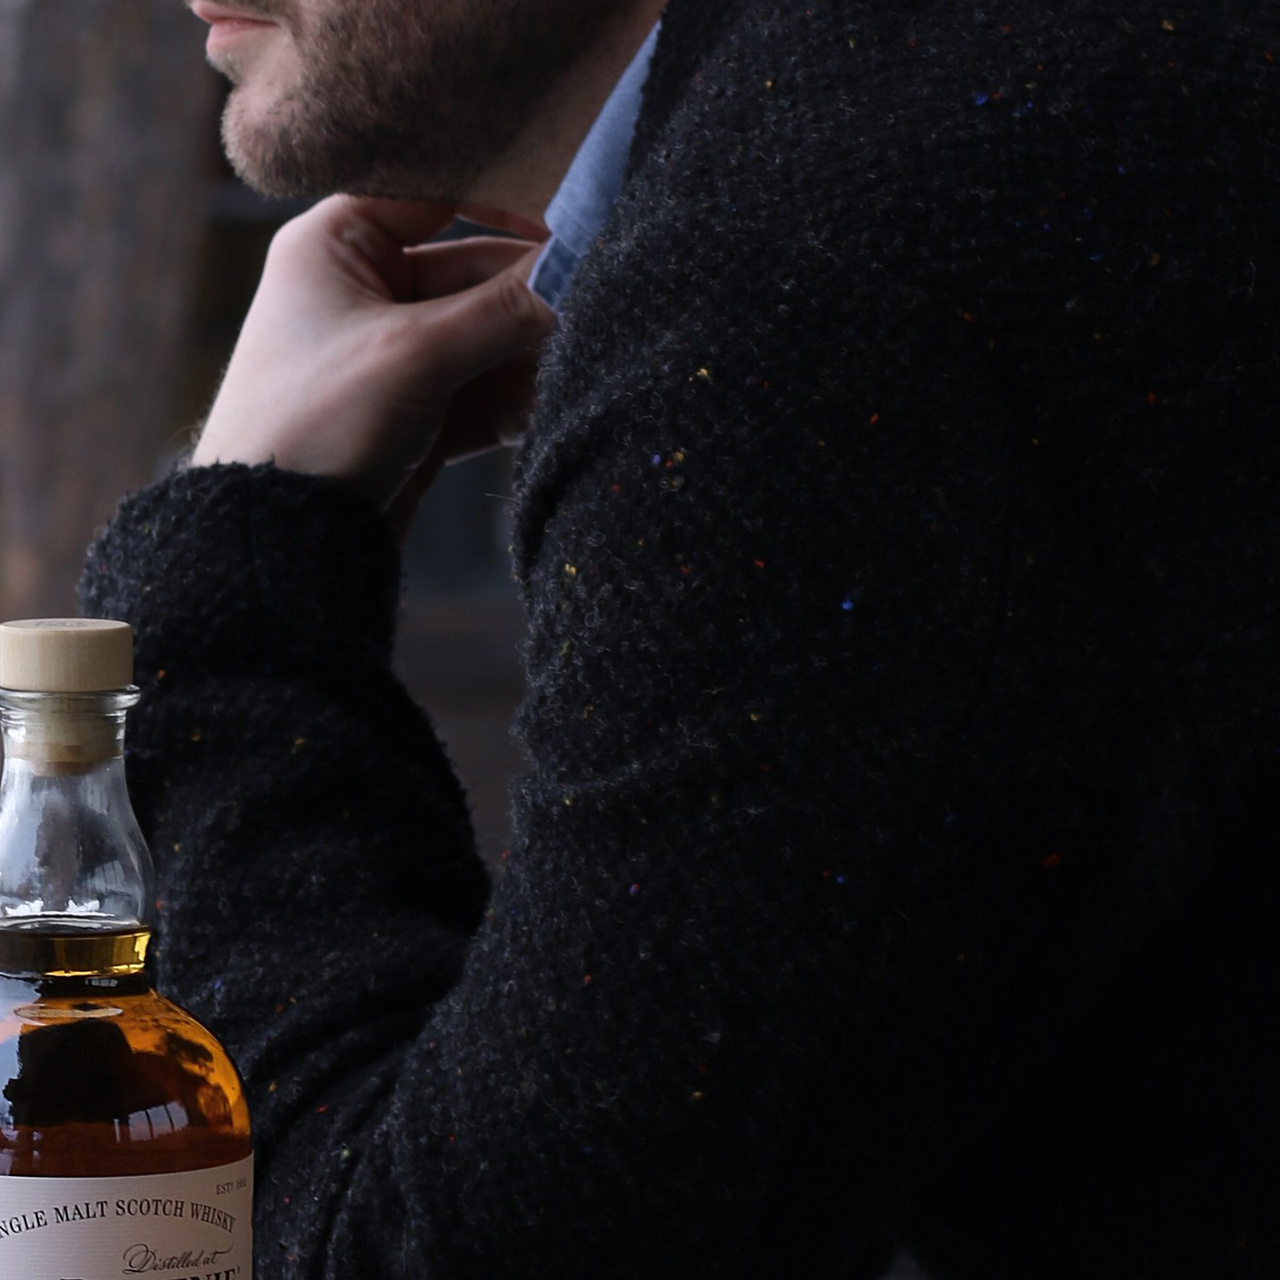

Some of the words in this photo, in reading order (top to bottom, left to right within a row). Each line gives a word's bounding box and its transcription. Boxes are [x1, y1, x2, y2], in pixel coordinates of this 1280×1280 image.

[53, 1200, 109, 1224] MALT
[115, 1198, 185, 1218] SCOTCH
[190, 1202, 236, 1233] WHISKY
[121, 1243, 202, 1275] Distilled
